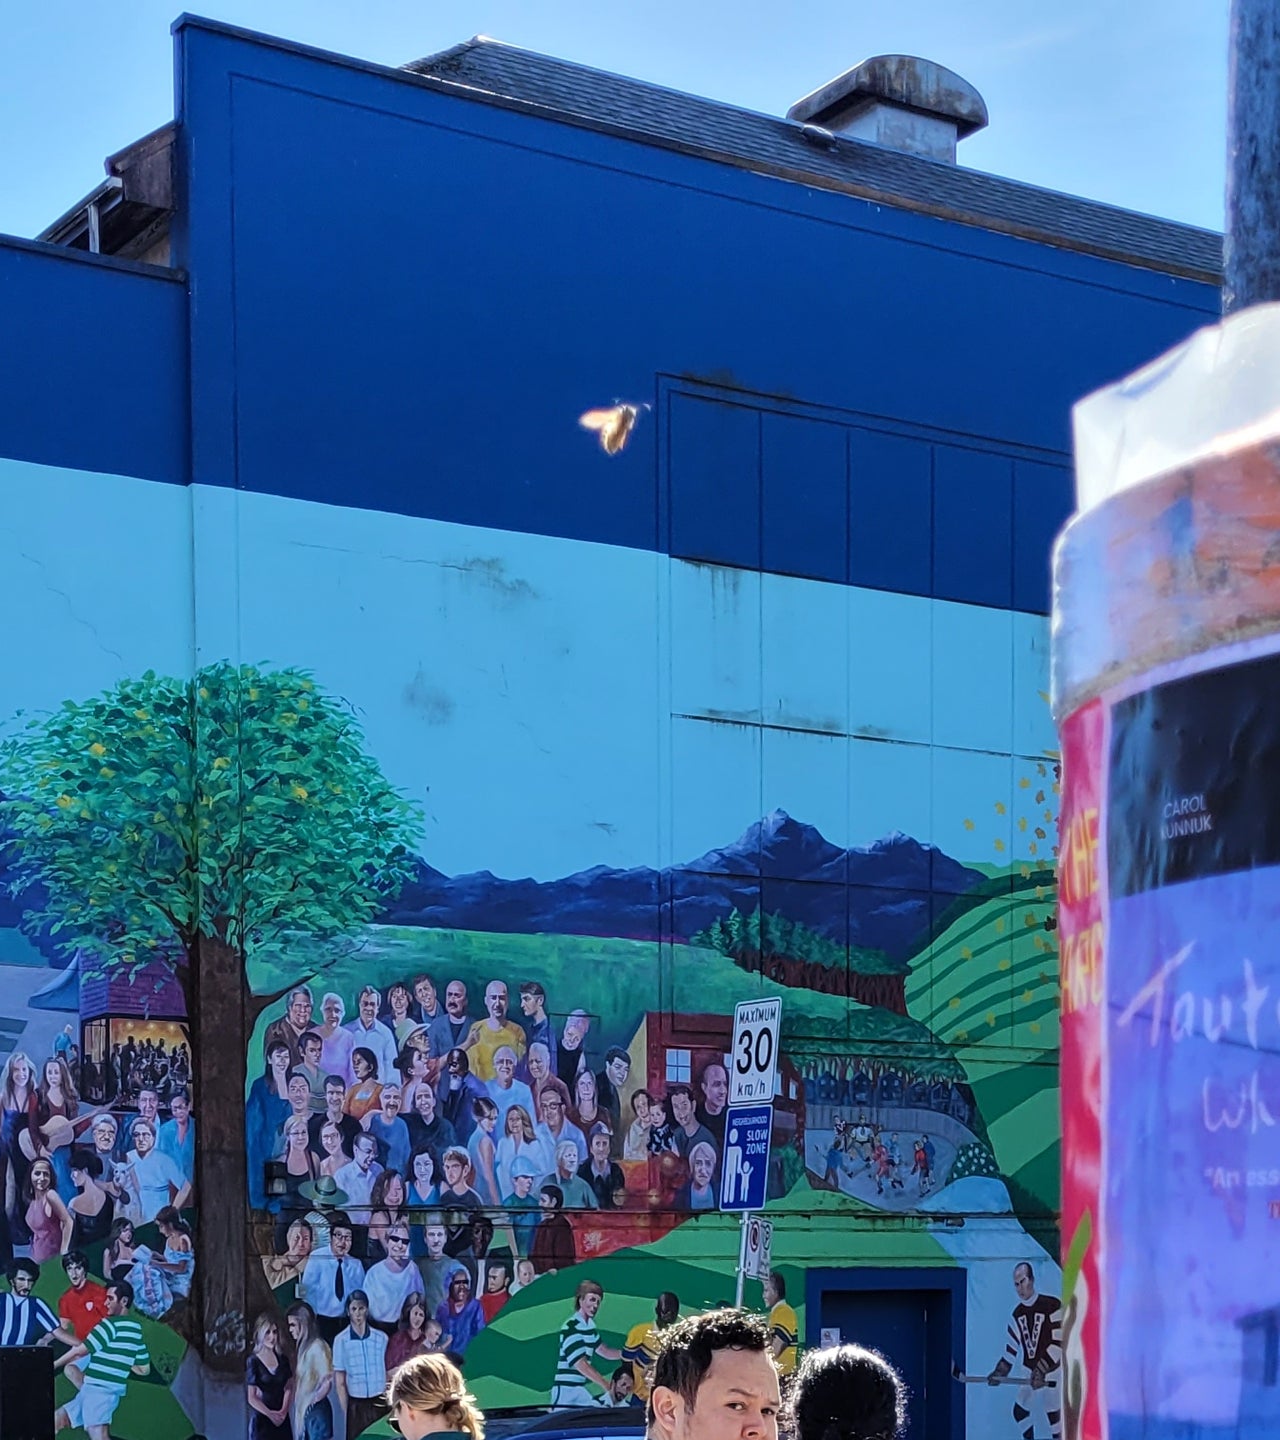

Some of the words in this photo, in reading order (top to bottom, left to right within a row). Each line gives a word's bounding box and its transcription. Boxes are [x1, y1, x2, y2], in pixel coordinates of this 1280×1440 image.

[1163, 793, 1207, 819] CAROL
[739, 1006, 776, 1024] MAXIMUM
[736, 1027, 772, 1075] 30
[737, 1077, 766, 1096] km/h
[746, 1128, 768, 1142] SLOW
[746, 1142, 767, 1155] ZONE
